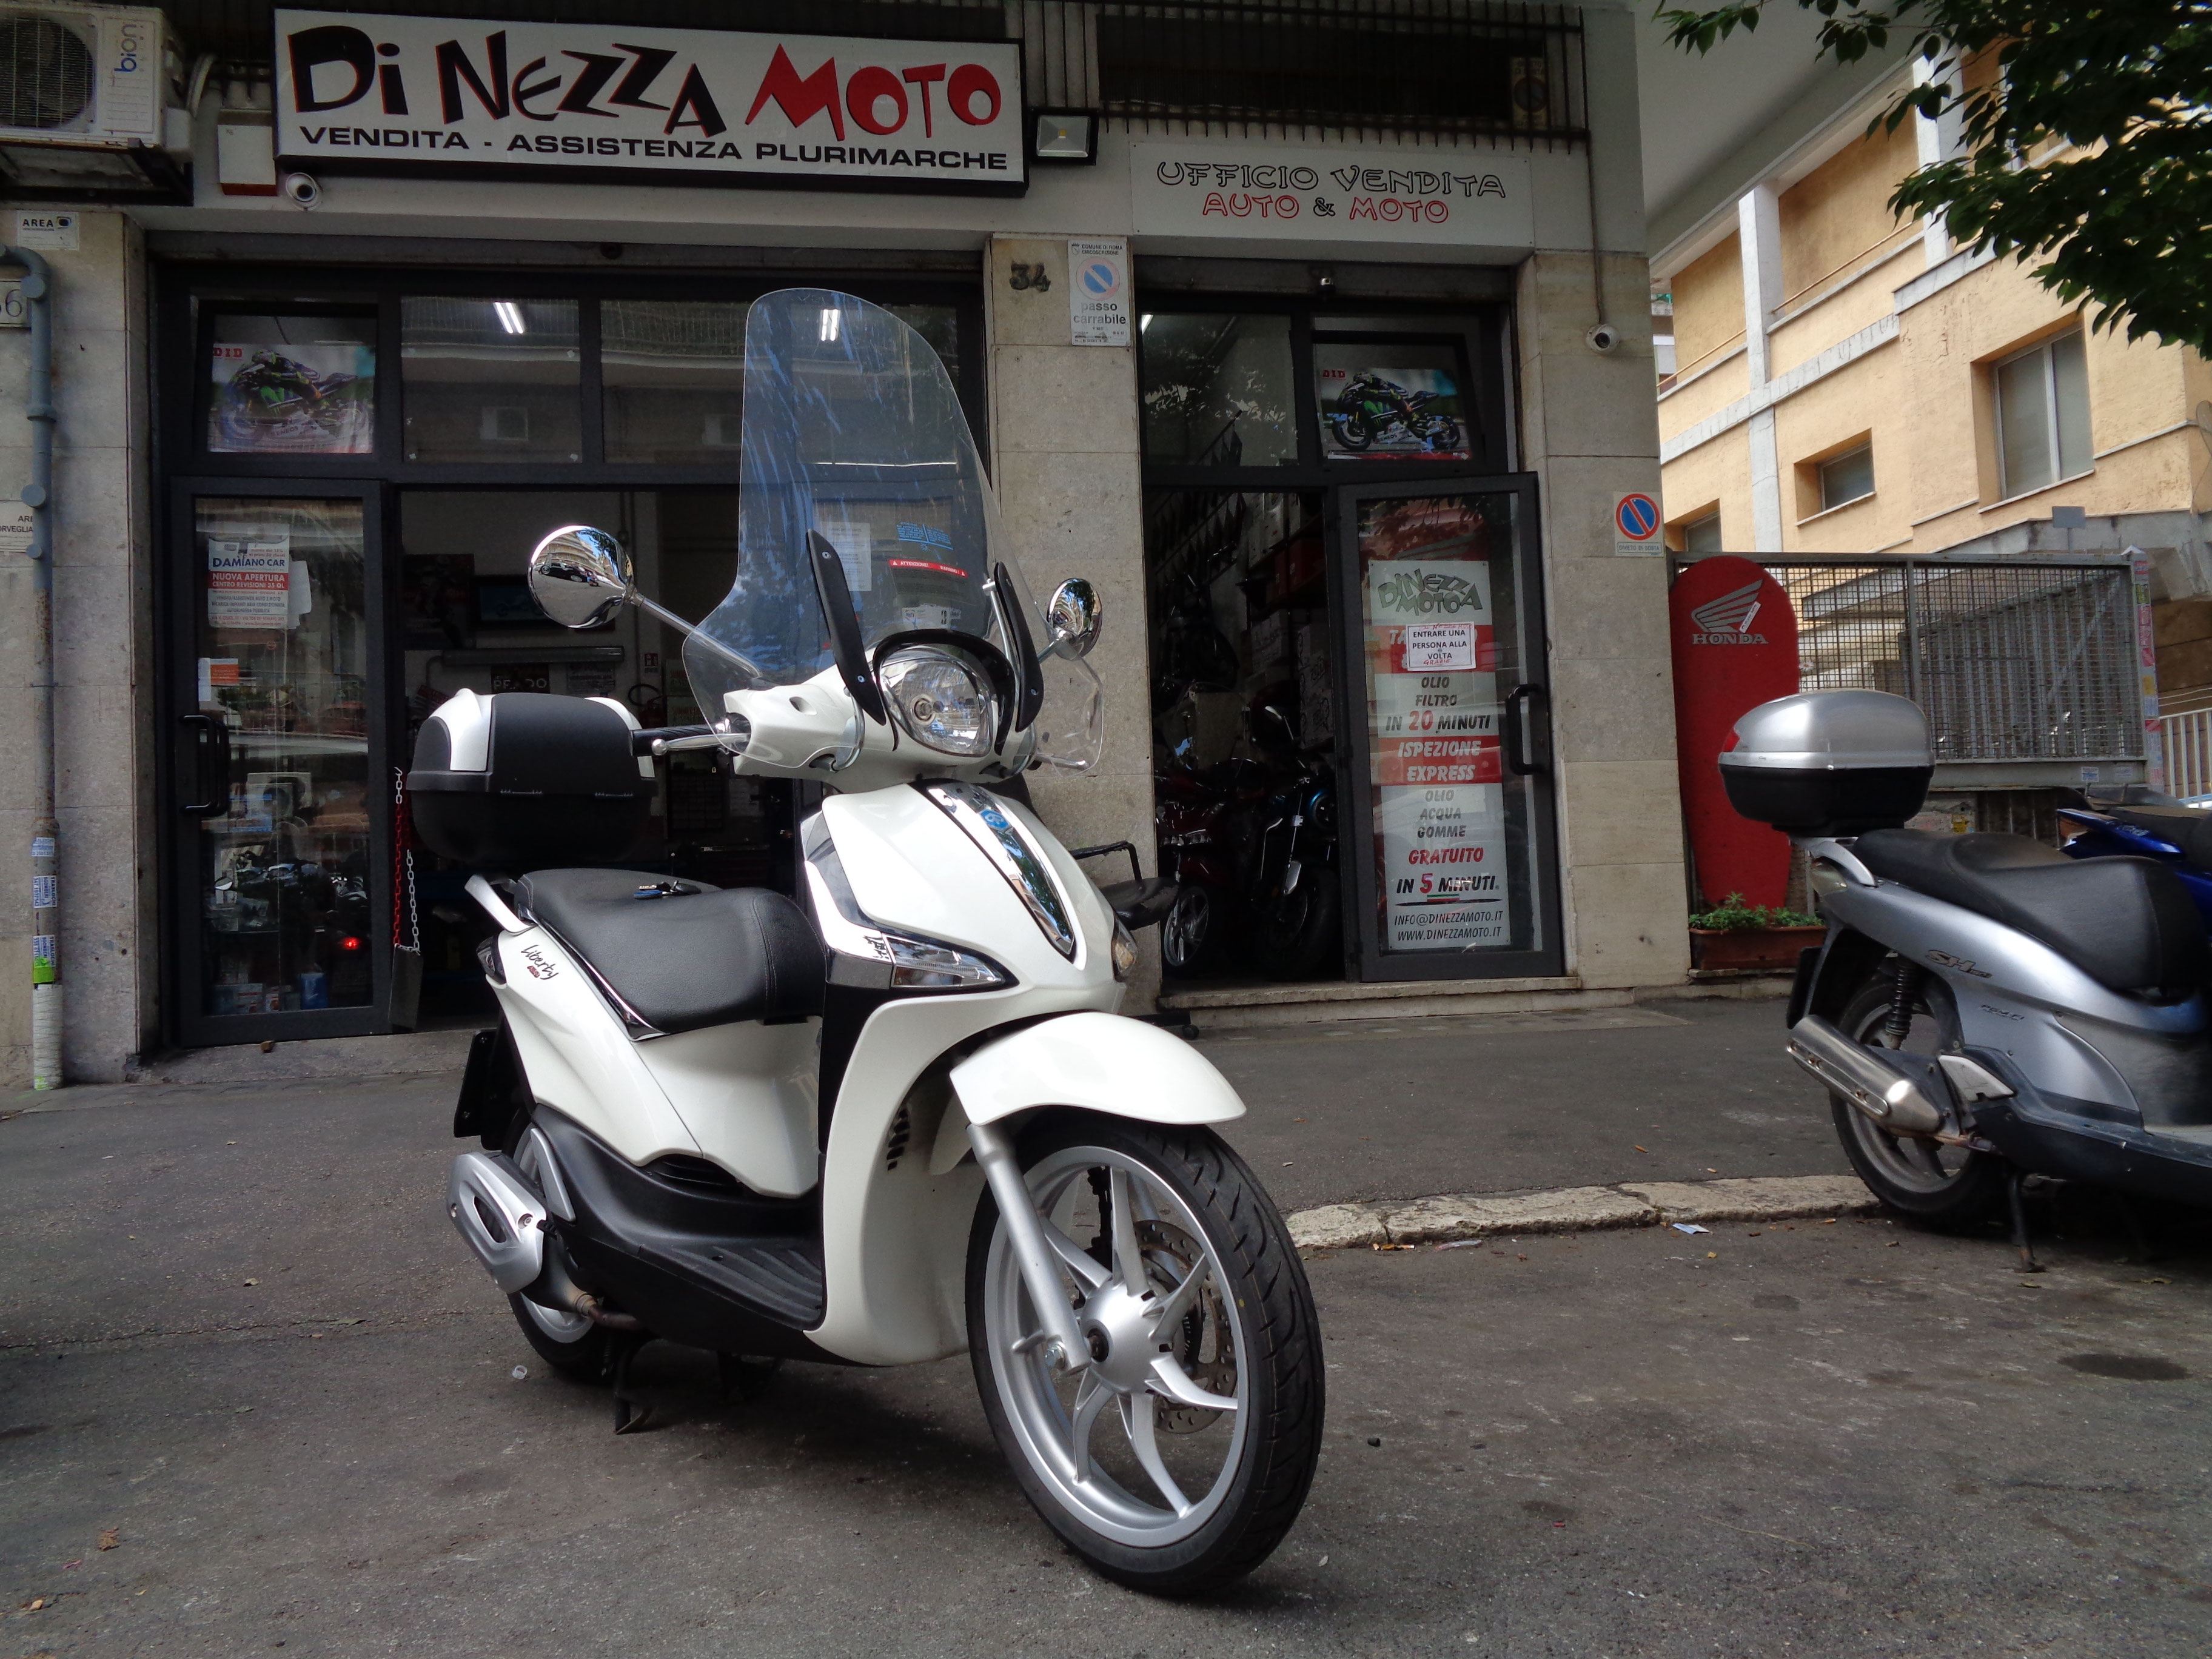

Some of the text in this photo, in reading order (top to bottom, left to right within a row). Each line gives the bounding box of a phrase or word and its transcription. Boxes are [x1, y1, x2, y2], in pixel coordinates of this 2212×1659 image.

[114, 24, 137, 72] bion
[745, 43, 1002, 141] MOTO
[300, 126, 470, 150] VENDITA
[507, 133, 743, 160] ASSISTENZA
[756, 143, 1007, 170] PLURIMARCHE
[1157, 161, 1507, 198] UFFICIO VENDITA
[1202, 192, 1449, 224] AUTO & MOTO
[22, 219, 54, 227] AREA
[1009, 261, 1051, 292] 34
[0, 289, 22, 317] 6
[1081, 303, 1118, 313] passo
[1073, 313, 1127, 324] carrabile
[212, 557, 265, 568] DAMIANO
[244, 573, 285, 581] APERTURA
[1395, 591, 1461, 616] MOTO
[1692, 634, 1769, 645] HONDA
[1421, 676, 1450, 689] OLIO
[1415, 694, 1458, 707] FILTRO
[1386, 709, 1491, 731] IN 20 MINUTI
[1398, 740, 1482, 758] ISPEZIONE
[1407, 765, 1476, 782] EXPRESS
[1425, 789, 1455, 802] OLIO
[1420, 807, 1461, 821] ACQUA
[1417, 825, 1467, 839] GOMME
[1409, 847, 1484, 865] GRATUITO
[1396, 878, 1415, 894] IN
[1419, 873, 1433, 894] 5
[1394, 910, 1504, 926] INFO@DINEZZAMOTO.IT
[1398, 927, 1502, 941] WWW.DINEZZAMOTO.IT
[521, 944, 560, 980] Liberty
[1925, 950, 1976, 973] SH
